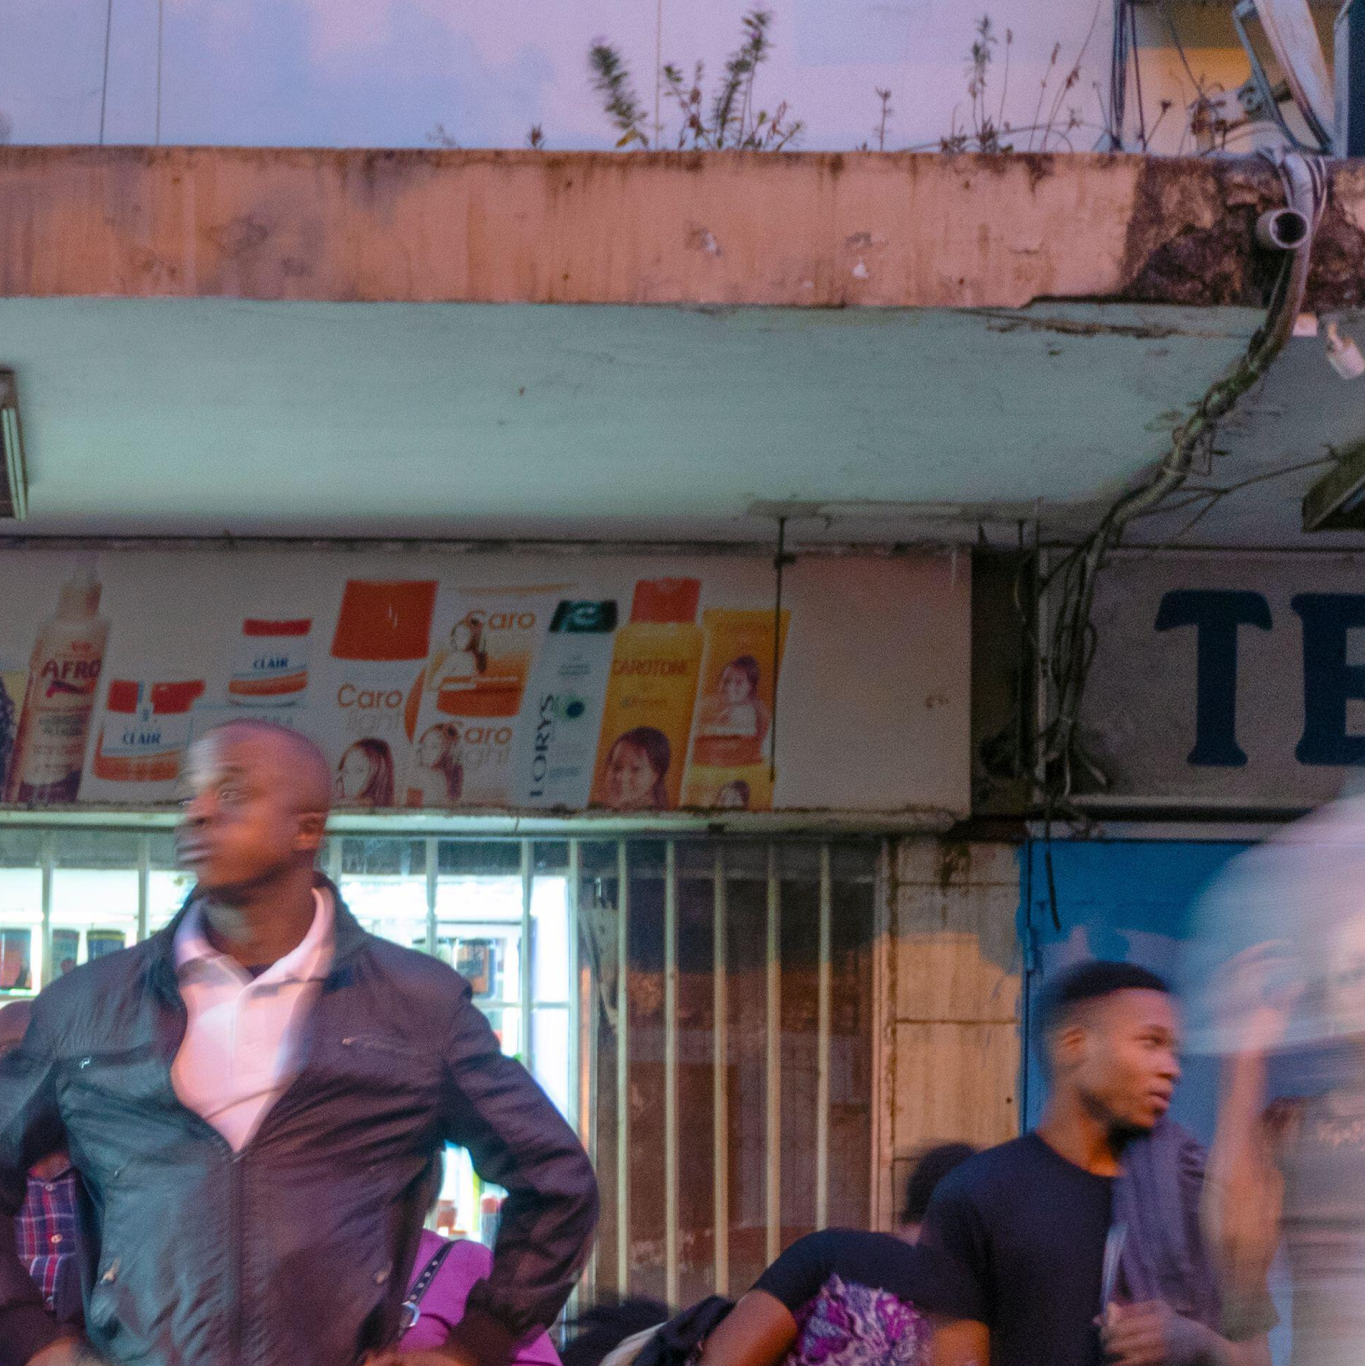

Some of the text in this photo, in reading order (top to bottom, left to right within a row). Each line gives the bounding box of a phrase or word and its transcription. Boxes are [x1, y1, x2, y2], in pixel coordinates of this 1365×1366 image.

[40, 659, 102, 679] AFRO
[336, 682, 403, 709] Caro
[528, 693, 555, 798] LORYS
